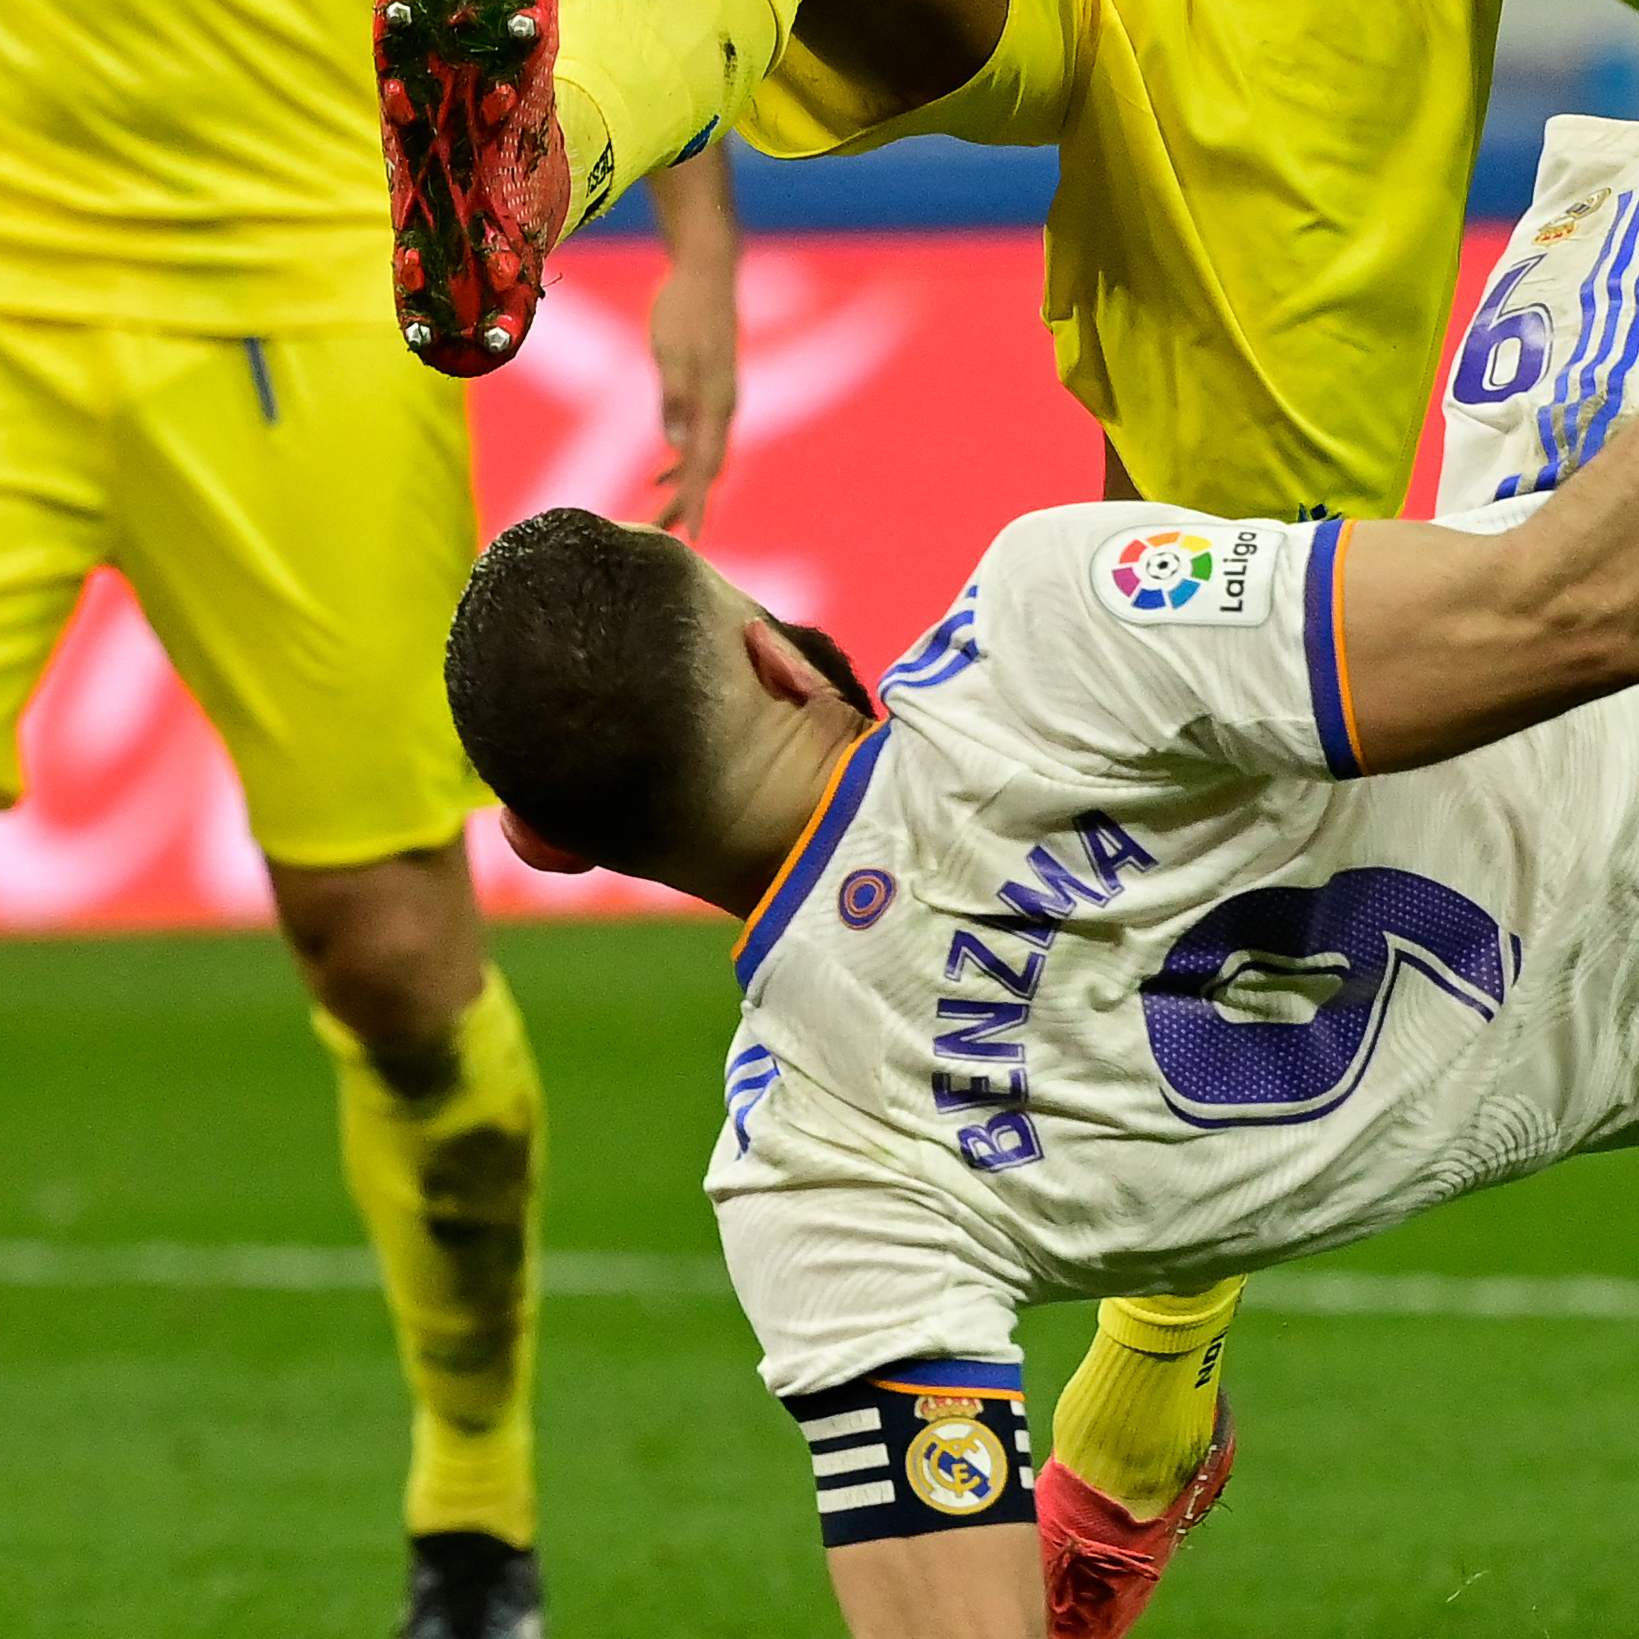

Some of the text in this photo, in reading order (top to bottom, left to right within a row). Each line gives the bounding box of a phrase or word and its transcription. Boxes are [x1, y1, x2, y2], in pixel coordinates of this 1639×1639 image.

[1220, 531, 1257, 612] LaLiga
[933, 808, 1158, 1173] BENZMA
[1140, 867, 1523, 1128] 9
